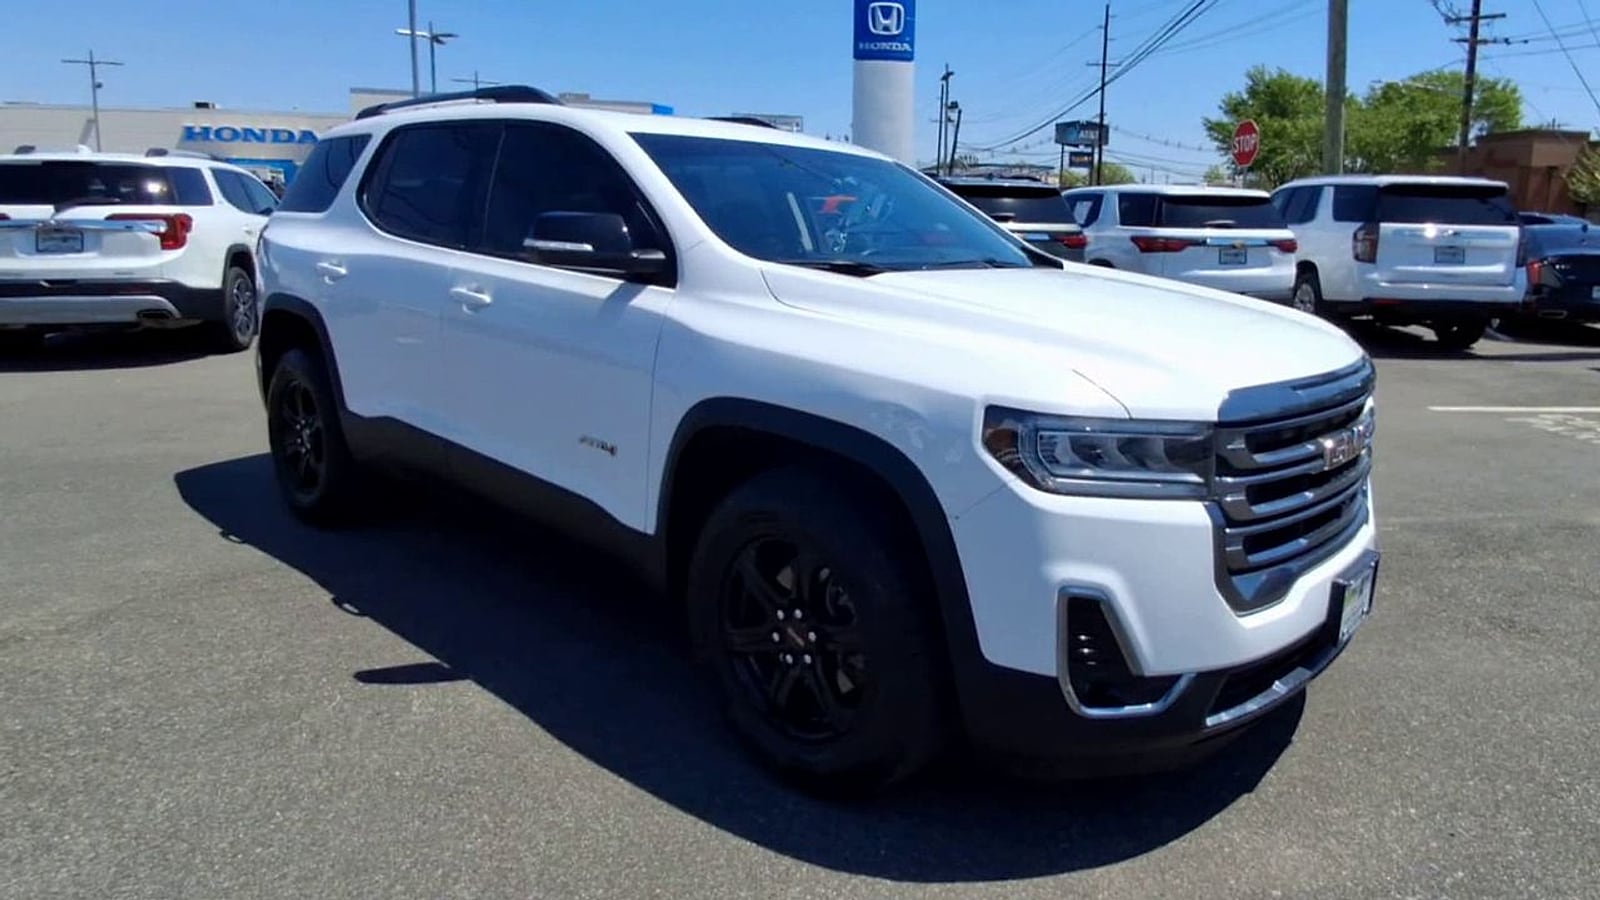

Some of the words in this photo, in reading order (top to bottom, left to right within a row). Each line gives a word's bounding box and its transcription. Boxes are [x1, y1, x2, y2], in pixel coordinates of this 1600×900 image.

[858, 41, 912, 51] HONDA
[182, 125, 319, 144] HONDA
[1232, 133, 1257, 153] STOP
